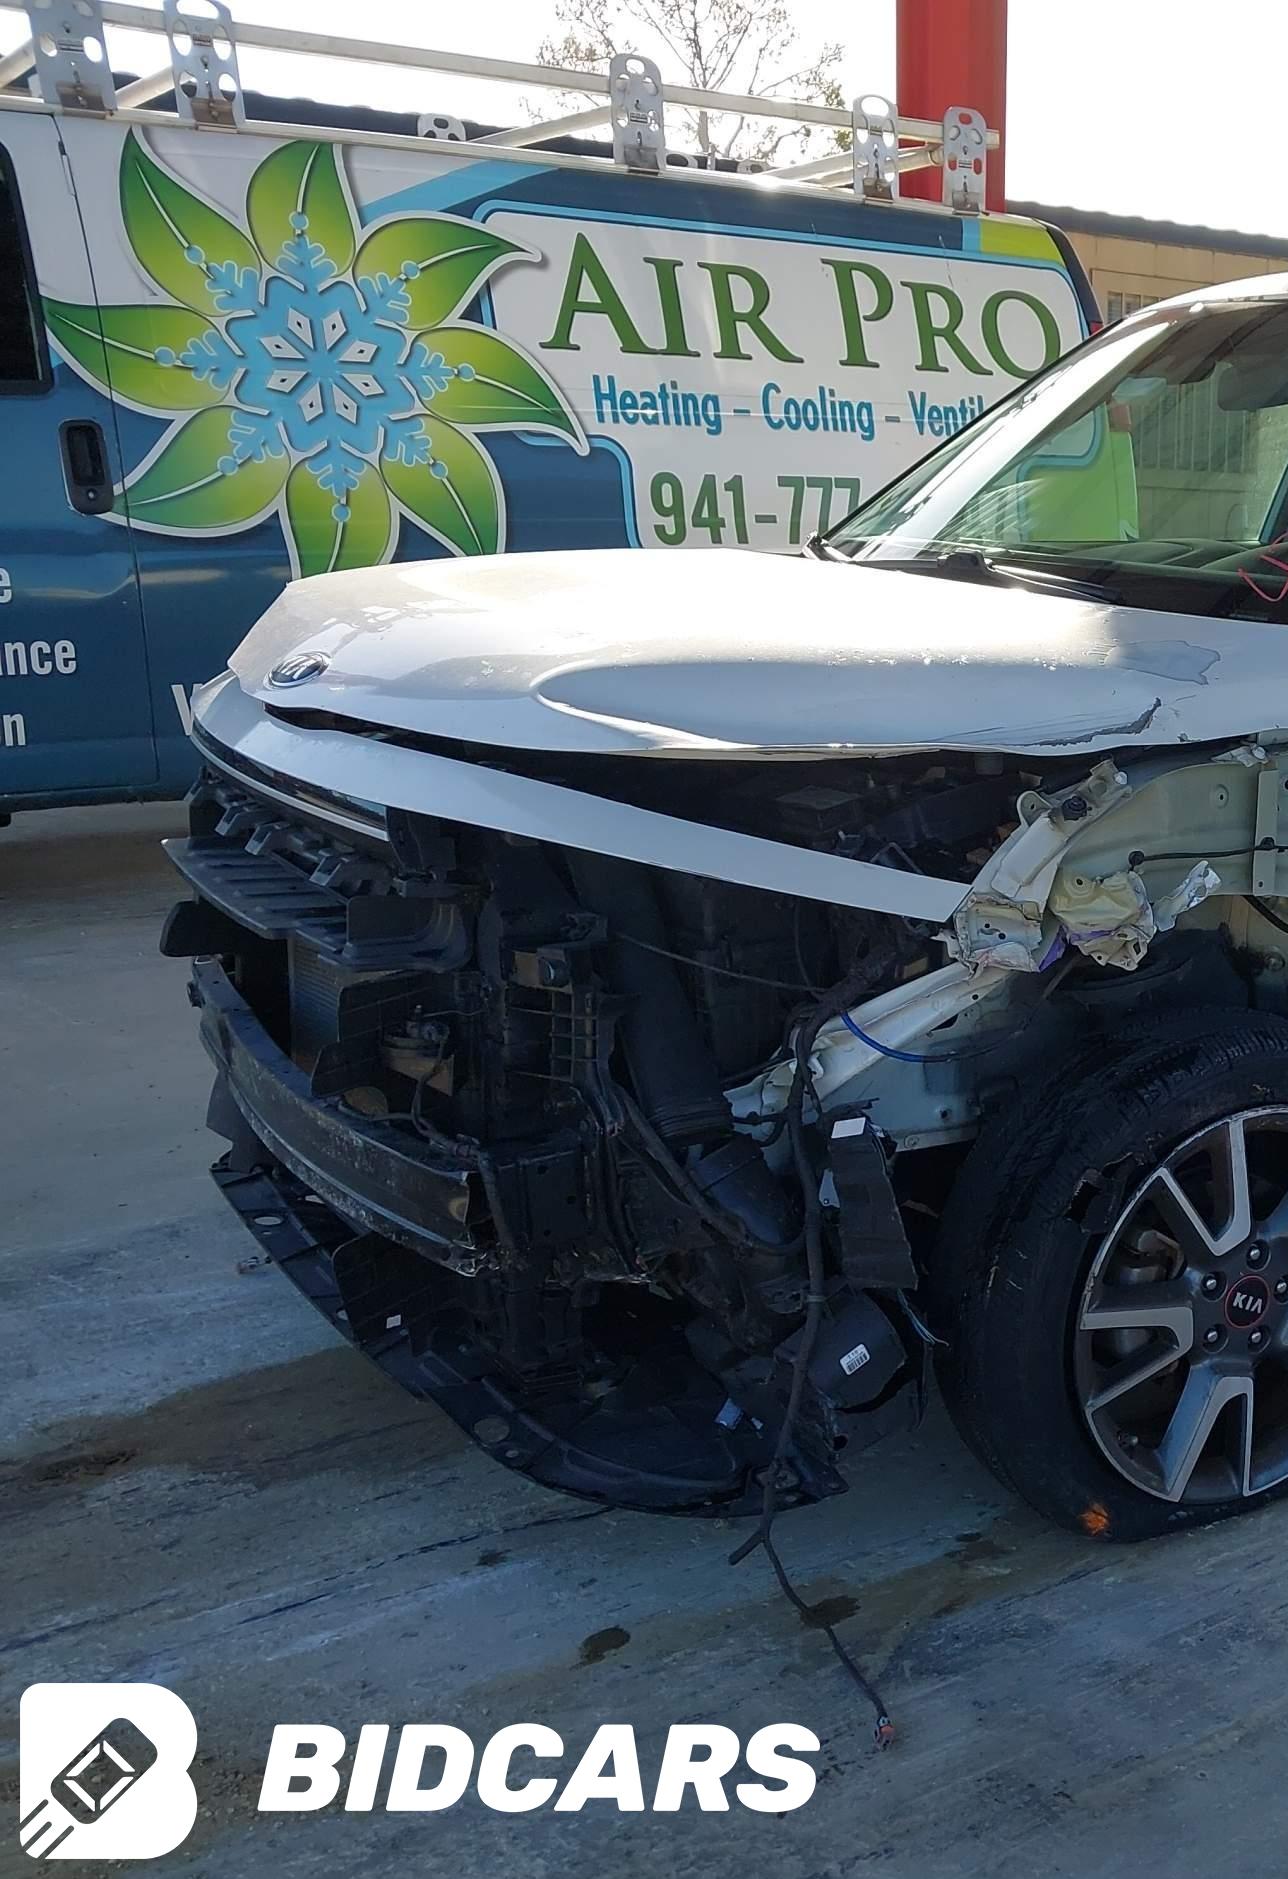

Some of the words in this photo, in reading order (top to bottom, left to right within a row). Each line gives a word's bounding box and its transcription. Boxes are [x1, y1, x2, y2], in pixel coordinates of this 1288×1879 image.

[539, 232, 804, 364] AIR
[821, 258, 1061, 379] PRO
[593, 374, 721, 436] Heating
[762, 382, 876, 442] Cooling
[649, 472, 861, 545] 941-777
[0, 639, 77, 676] nce
[0, 712, 27, 747] n
[1232, 1291, 1263, 1314] KIA
